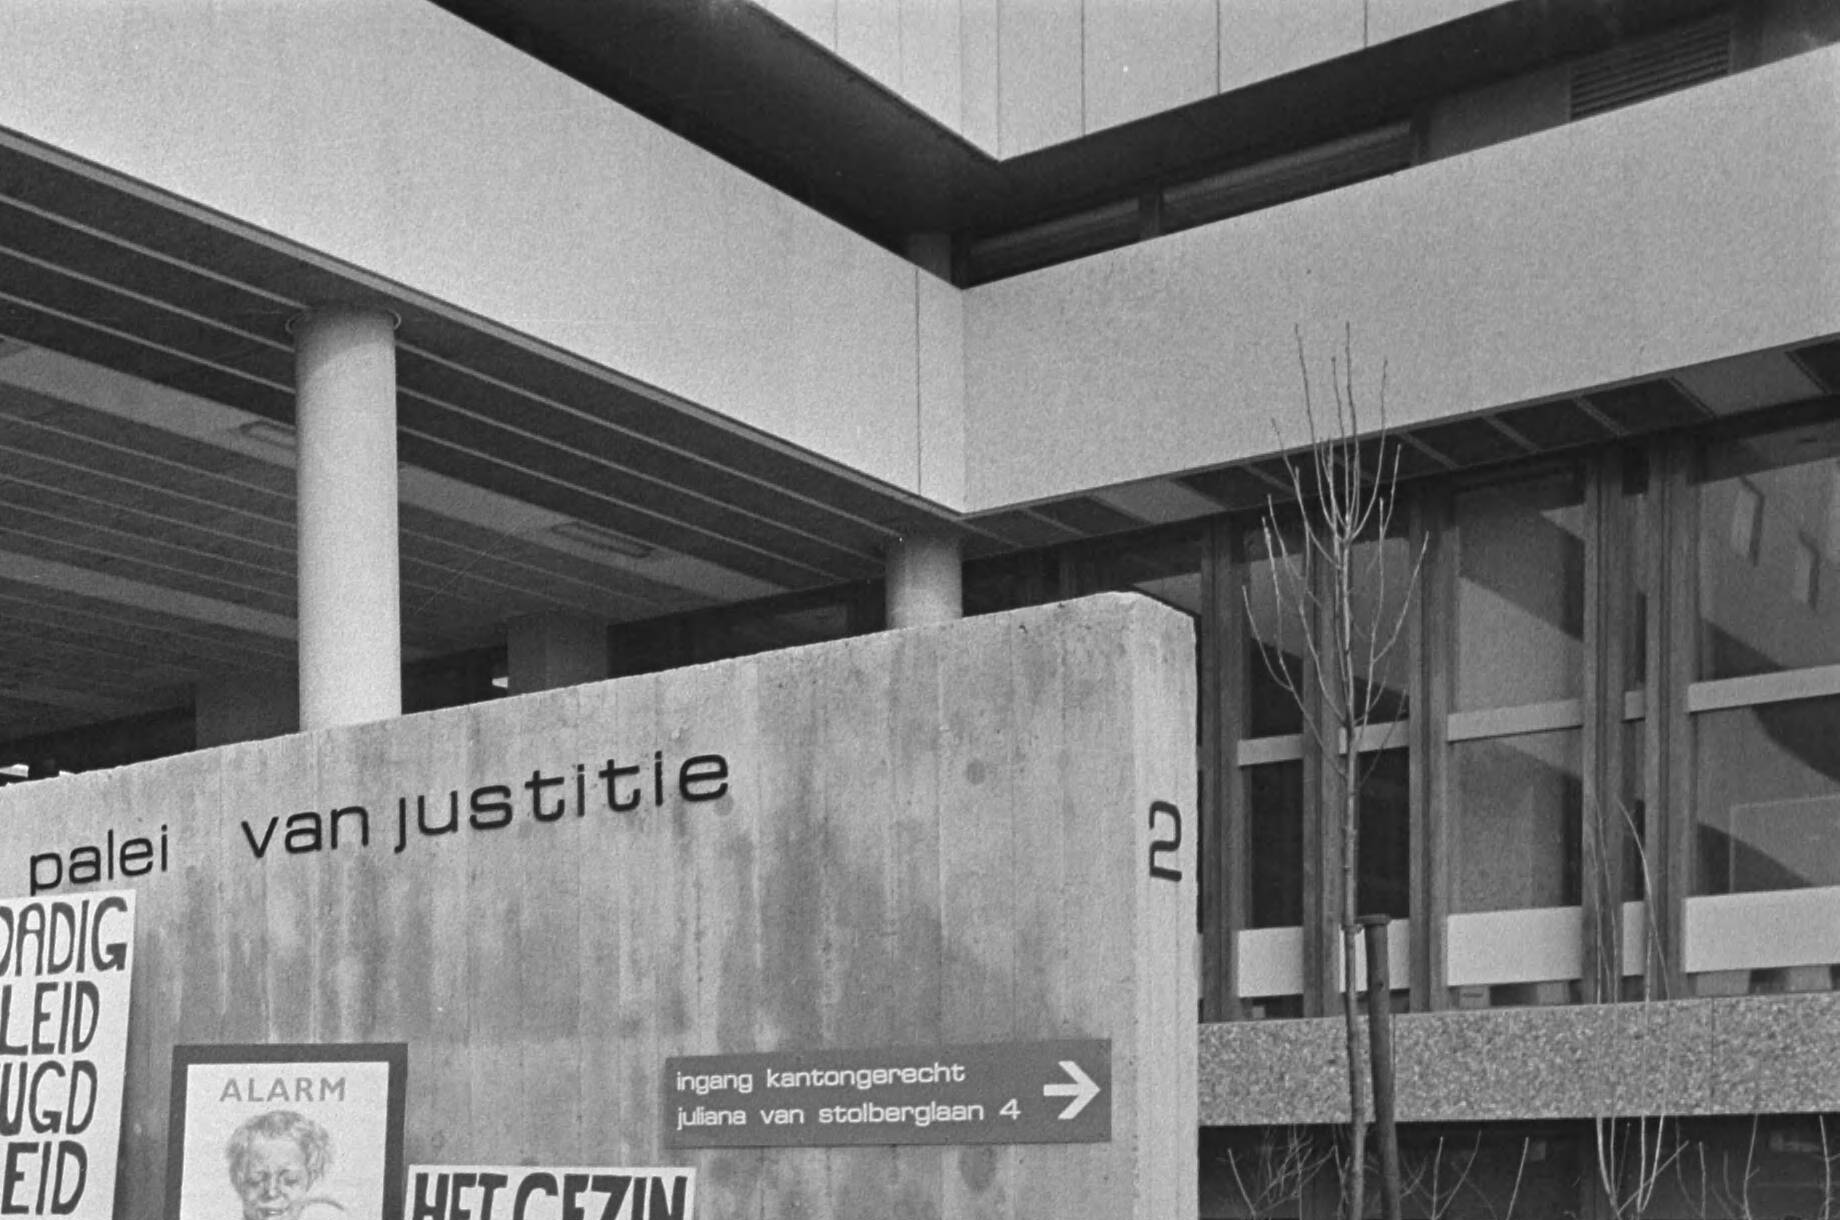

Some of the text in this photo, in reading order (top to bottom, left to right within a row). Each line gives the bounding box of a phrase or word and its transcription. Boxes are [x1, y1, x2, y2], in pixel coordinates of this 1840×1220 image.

[30, 750, 730, 896] palei van justitie
[1148, 800, 1182, 882] 2
[220, 1077, 346, 1102] ALARM
[676, 1062, 965, 1094] ingang kantongerecht
[676, 1098, 1021, 1130] juliana van stolberglaan 4
